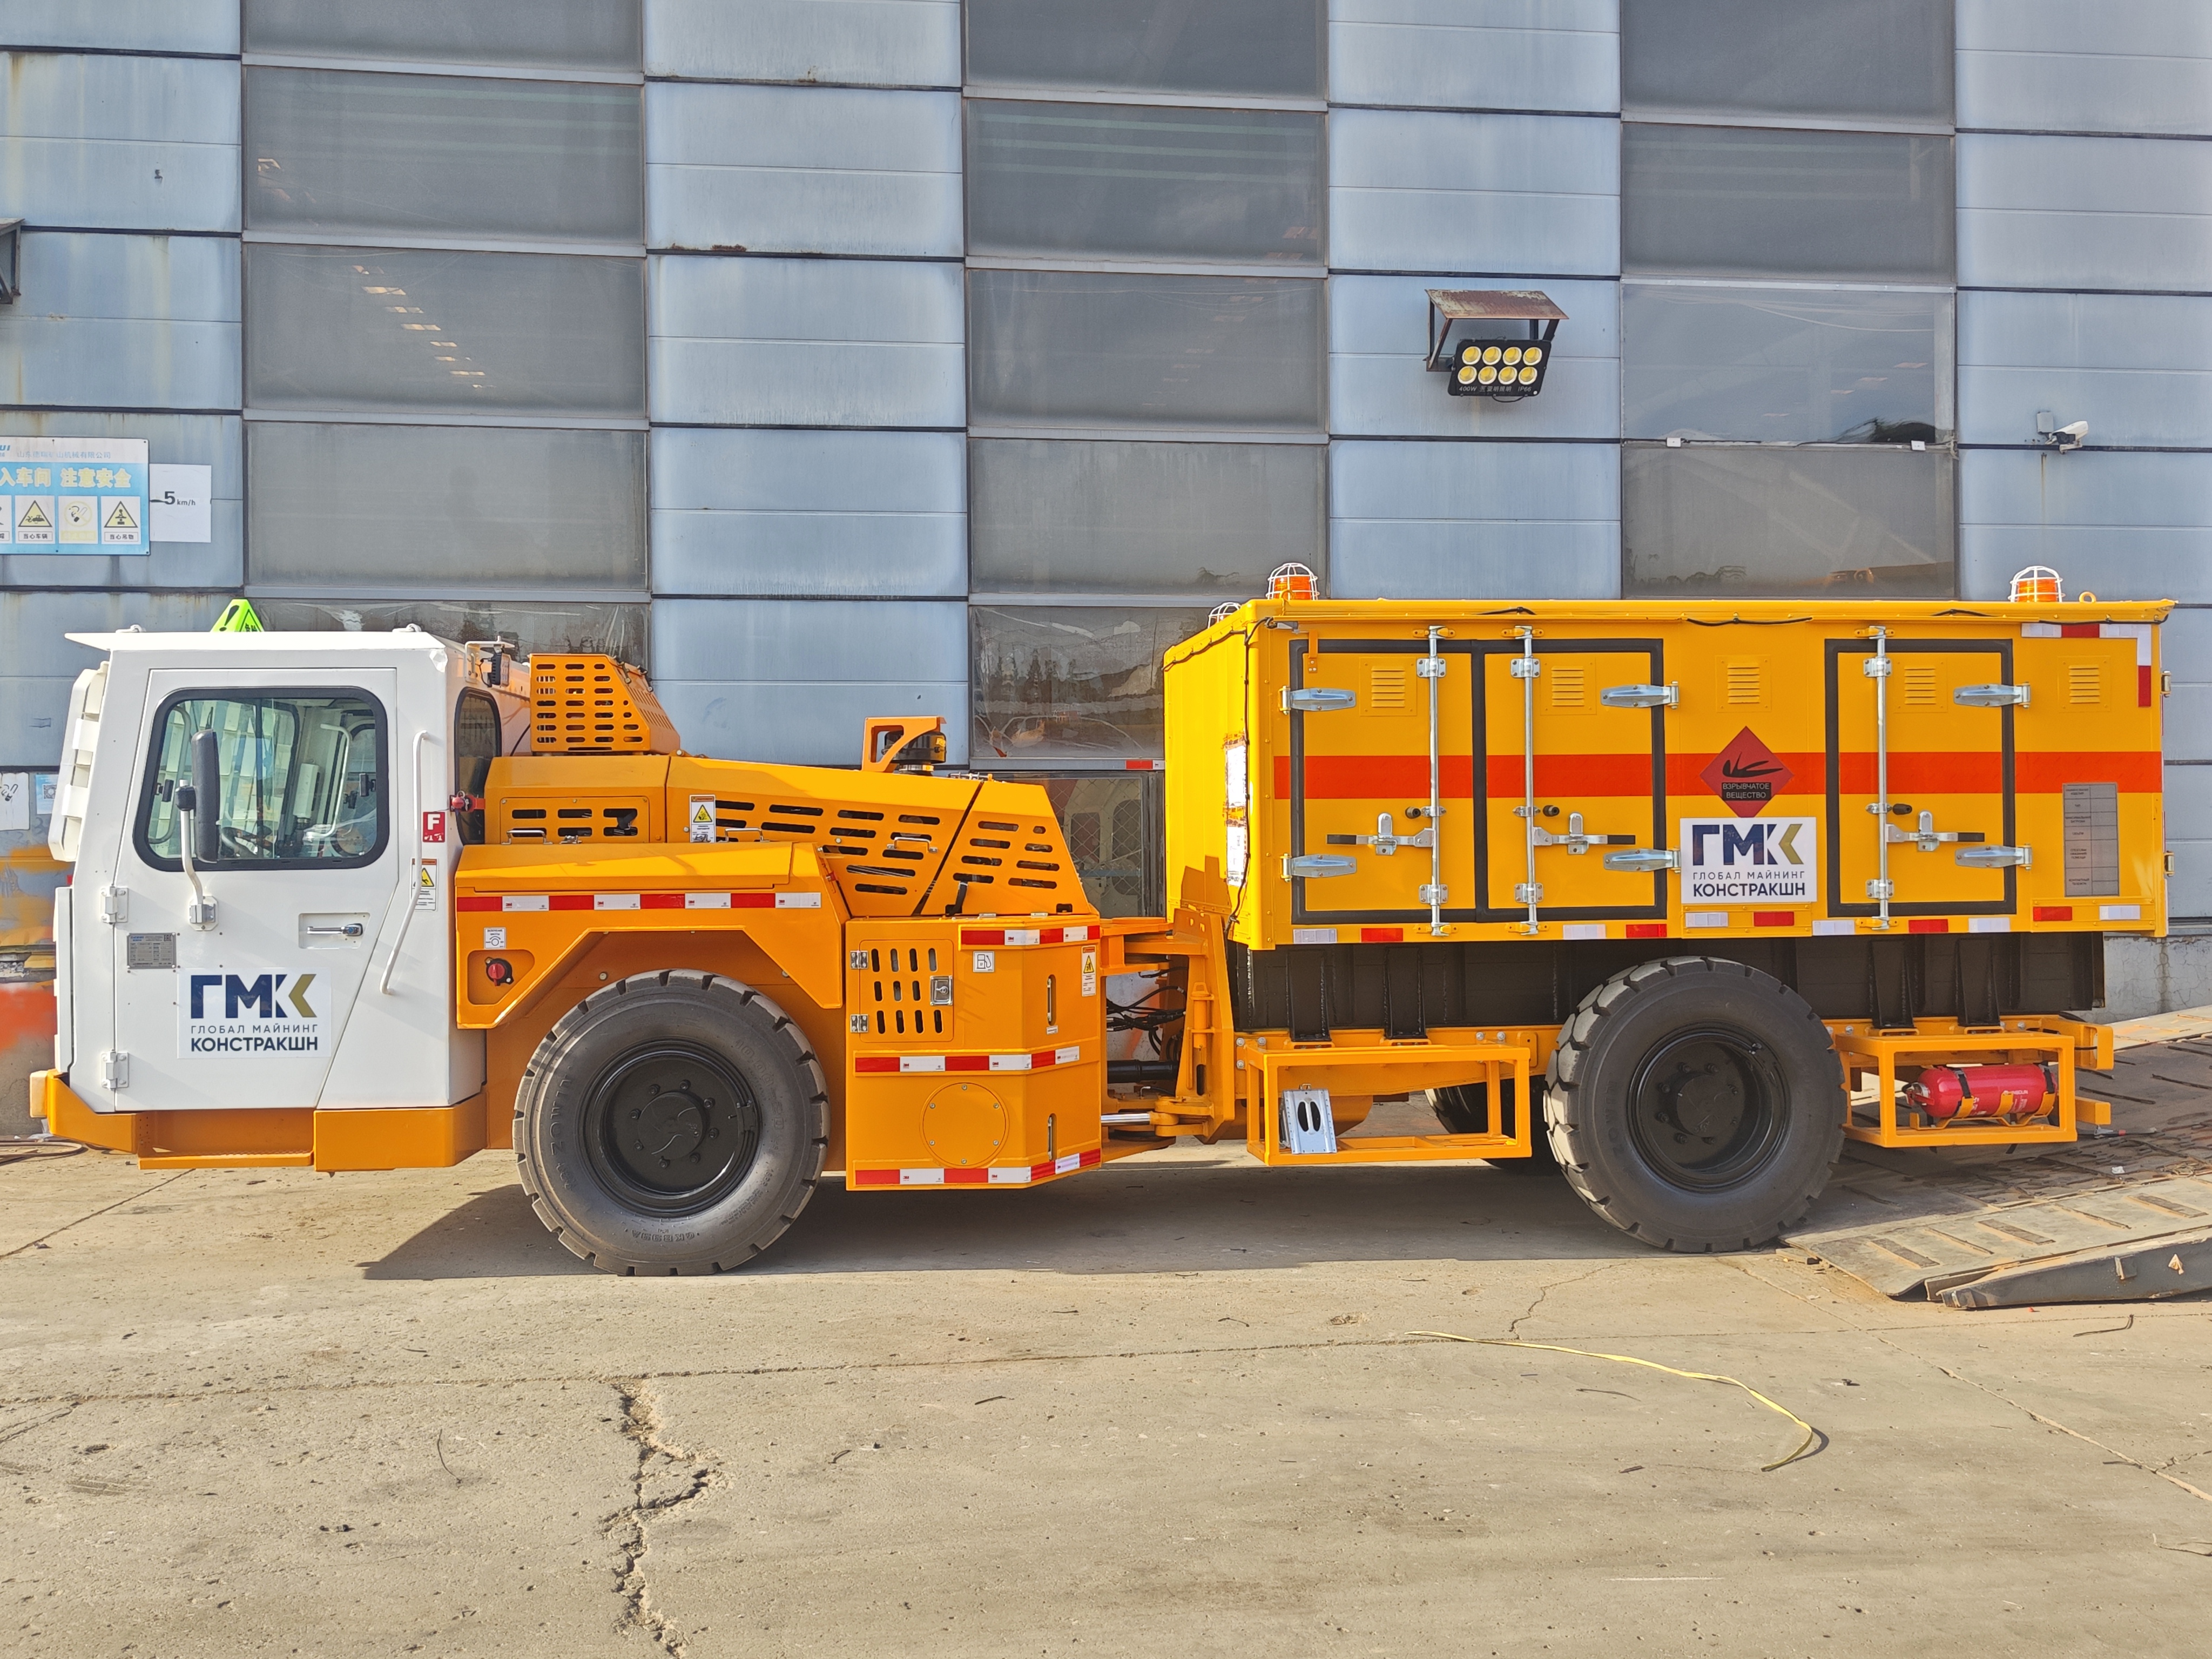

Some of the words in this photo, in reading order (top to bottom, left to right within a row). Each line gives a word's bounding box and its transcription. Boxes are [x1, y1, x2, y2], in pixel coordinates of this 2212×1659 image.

[60, 467, 132, 488] 注意安全
[164, 491, 176, 505] 5
[1693, 872, 1741, 880] ГЛОБАЛ
[1748, 870, 1805, 879] МАЙНИНГ
[1693, 882, 1805, 897] КОНСТРАКШН
[191, 974, 318, 1019] ГМК
[191, 1025, 245, 1034] ГЛОБАЛ
[253, 1023, 318, 1033] МАЙНИНГ
[191, 1036, 318, 1052] КОНСТРАКШН
